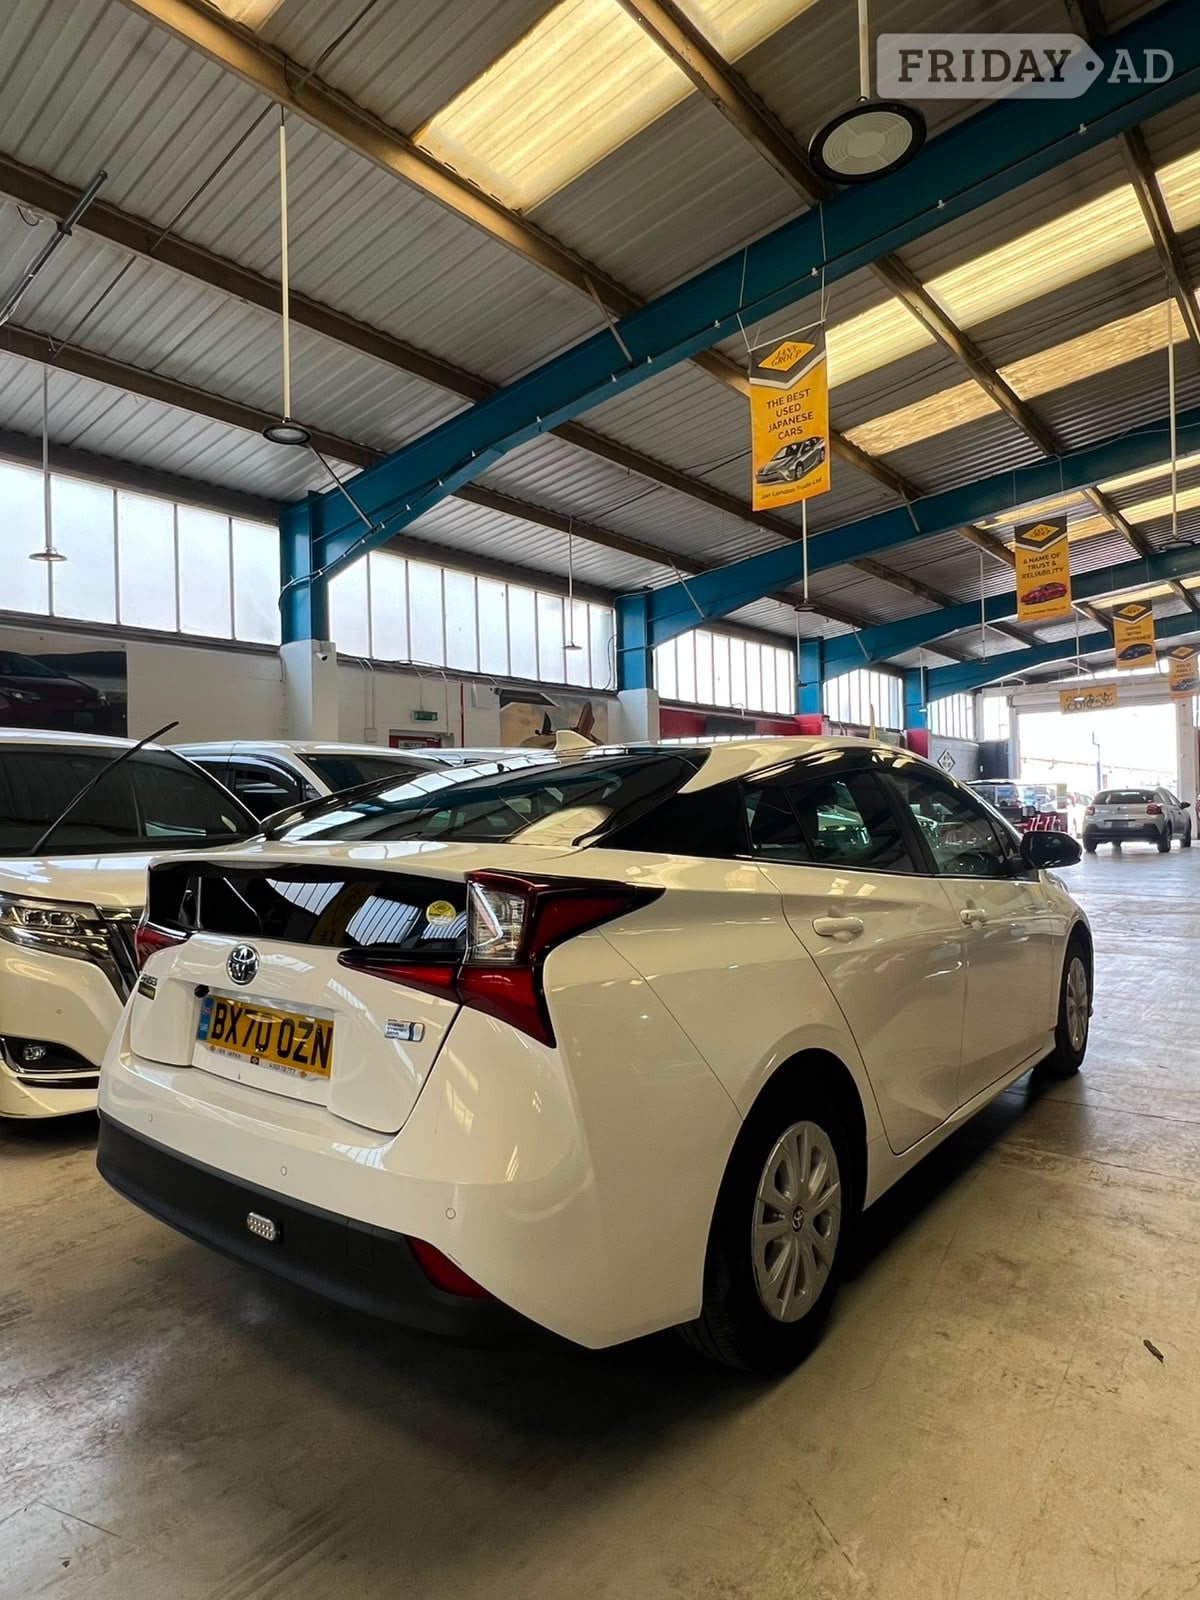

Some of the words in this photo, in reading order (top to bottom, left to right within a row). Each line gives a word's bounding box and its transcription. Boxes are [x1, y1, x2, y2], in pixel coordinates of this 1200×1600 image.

[771, 350, 802, 367] GROUP
[766, 396, 785, 409] THE
[786, 388, 811, 403] BEST
[776, 403, 801, 417] USED
[768, 411, 814, 433] JAPANESE
[778, 426, 803, 440] CARS
[1029, 554, 1049, 563] NAME
[1051, 552, 1061, 560] OF
[1022, 567, 1064, 579] RELIABILITY
[1028, 561, 1050, 571] TRUST
[211, 1003, 273, 1053] BX70
[277, 1018, 334, 1069] OZN
